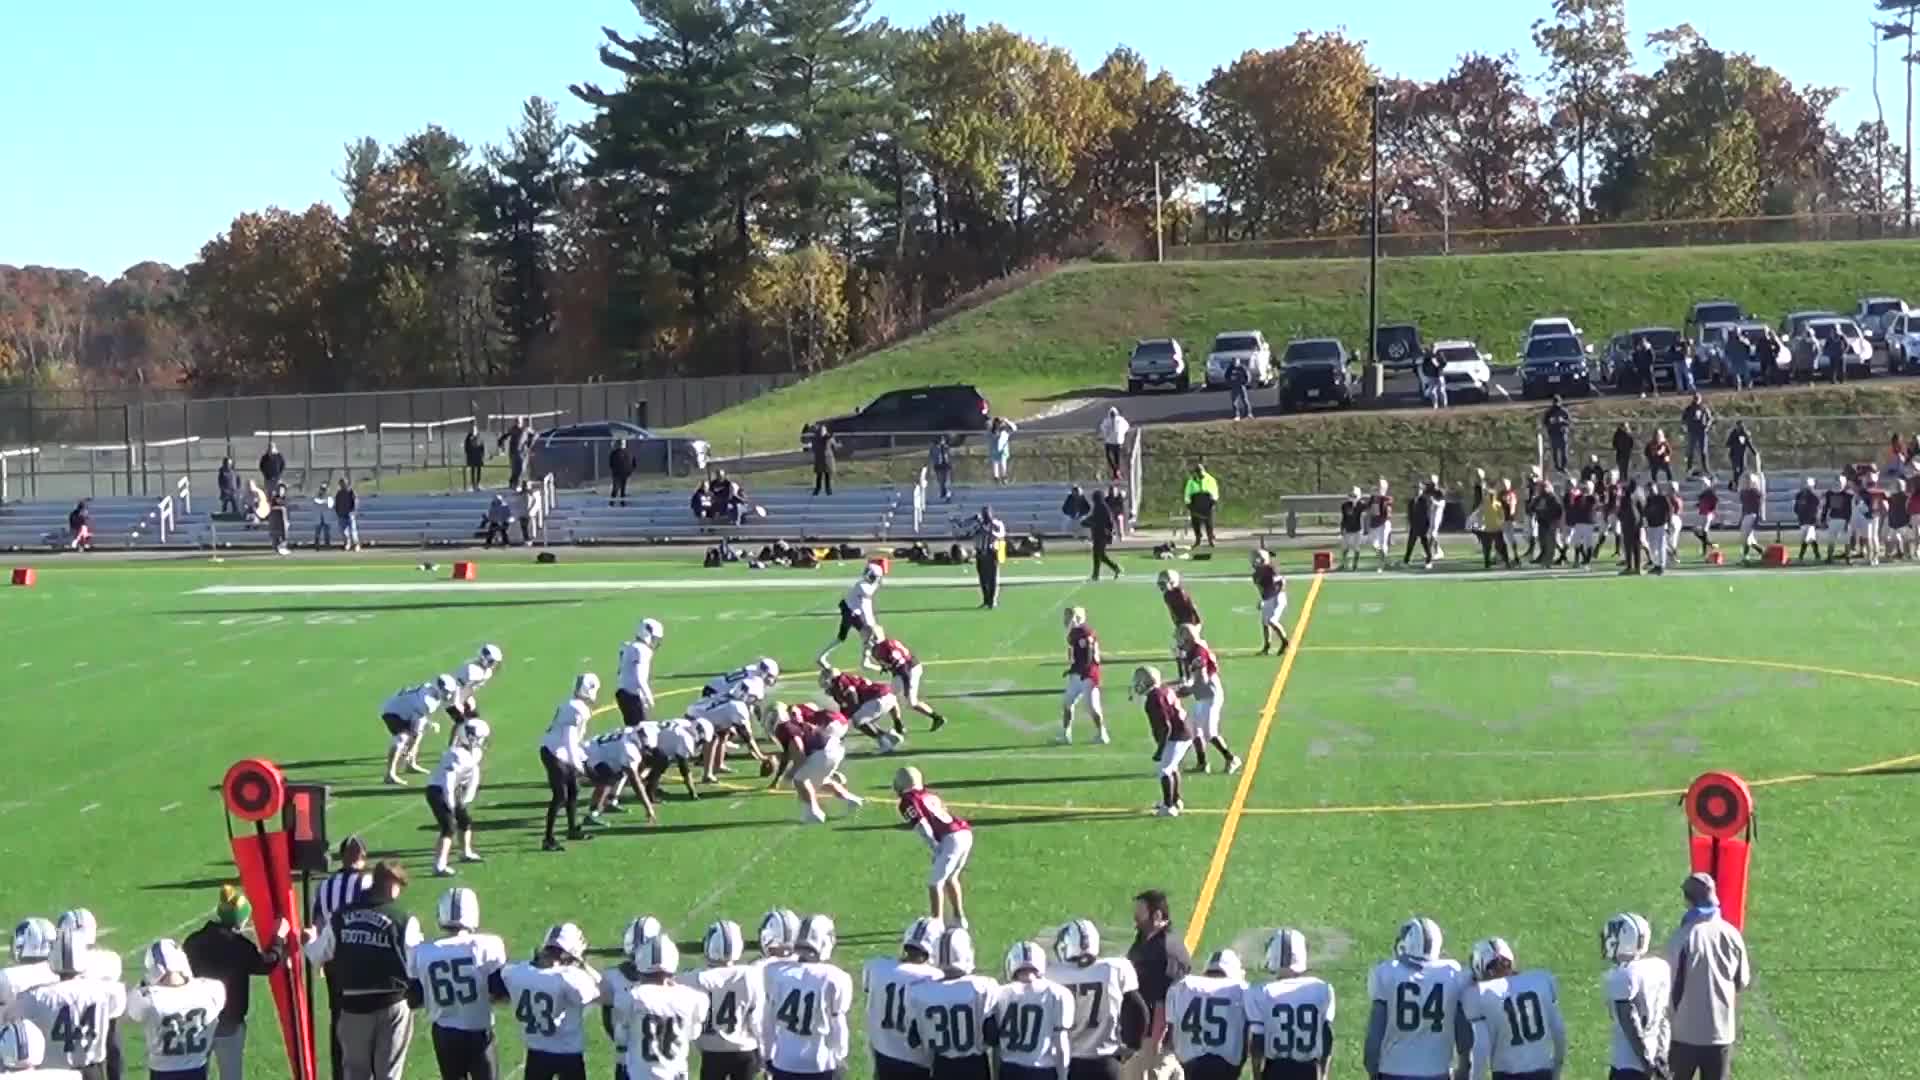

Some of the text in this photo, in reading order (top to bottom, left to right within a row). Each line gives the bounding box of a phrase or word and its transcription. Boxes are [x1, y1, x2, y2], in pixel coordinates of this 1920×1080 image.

[293, 792, 313, 840] 1
[341, 929, 392, 948] FOOTBALL
[428, 957, 478, 1006] 65
[52, 1002, 97, 1053] 44
[515, 988, 554, 1036] 43
[777, 988, 816, 1036] 41
[925, 1004, 975, 1050] 30
[1000, 1003, 1044, 1053] 40
[1181, 996, 1231, 1047] 45
[1272, 1002, 1319, 1052] 39
[1396, 982, 1445, 1032] 64
[1503, 991, 1546, 1046] 10
